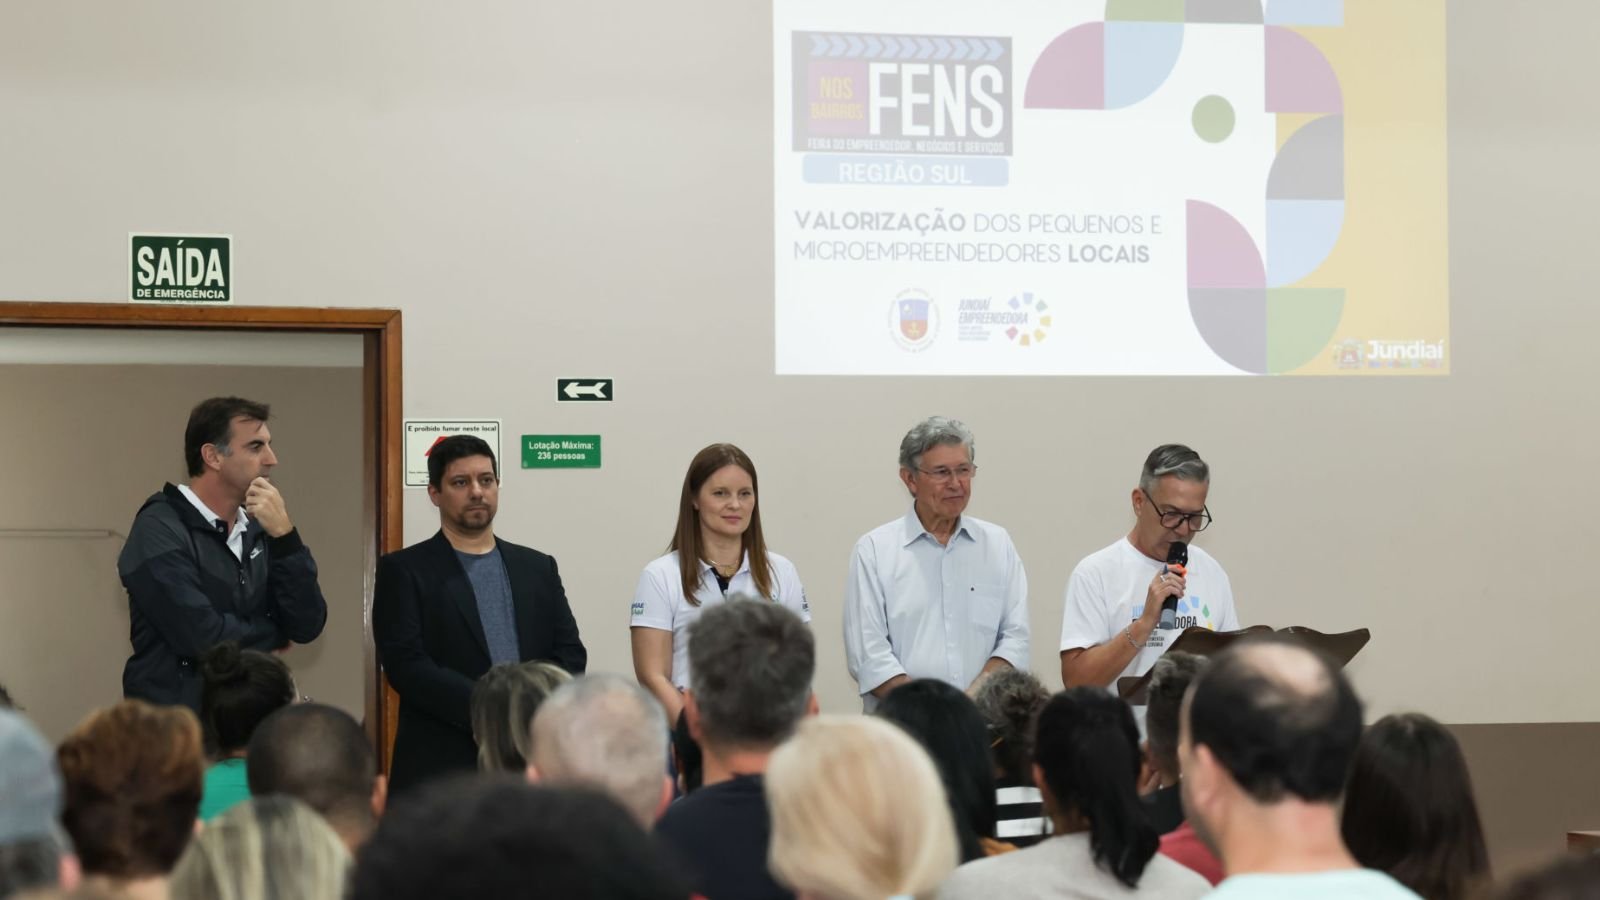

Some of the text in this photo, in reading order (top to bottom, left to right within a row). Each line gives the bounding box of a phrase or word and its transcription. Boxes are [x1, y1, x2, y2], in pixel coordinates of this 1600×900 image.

[820, 76, 854, 99] NOS
[868, 62, 1004, 138] FENS
[811, 102, 864, 120] BAIRROS
[808, 138, 831, 150] FEIRA
[833, 139, 845, 150] DO
[964, 141, 1004, 154] SERVIÇOS
[839, 160, 972, 184] REGIÃO SUL
[794, 208, 1162, 236] VALORIZAÇÃO DOS PEQUENOS E
[794, 241, 1150, 263] MICROEMPREENDEDORES LOCAIS
[137, 240, 225, 286] SAÍDA
[137, 287, 225, 299] DE EMERGÊNCIA
[958, 312, 1028, 324] EMPREENDEDORA
[1368, 338, 1444, 359] Jundiaí
[529, 440, 594, 450] Lotação Máxima:
[553, 452, 586, 461] pessoas
